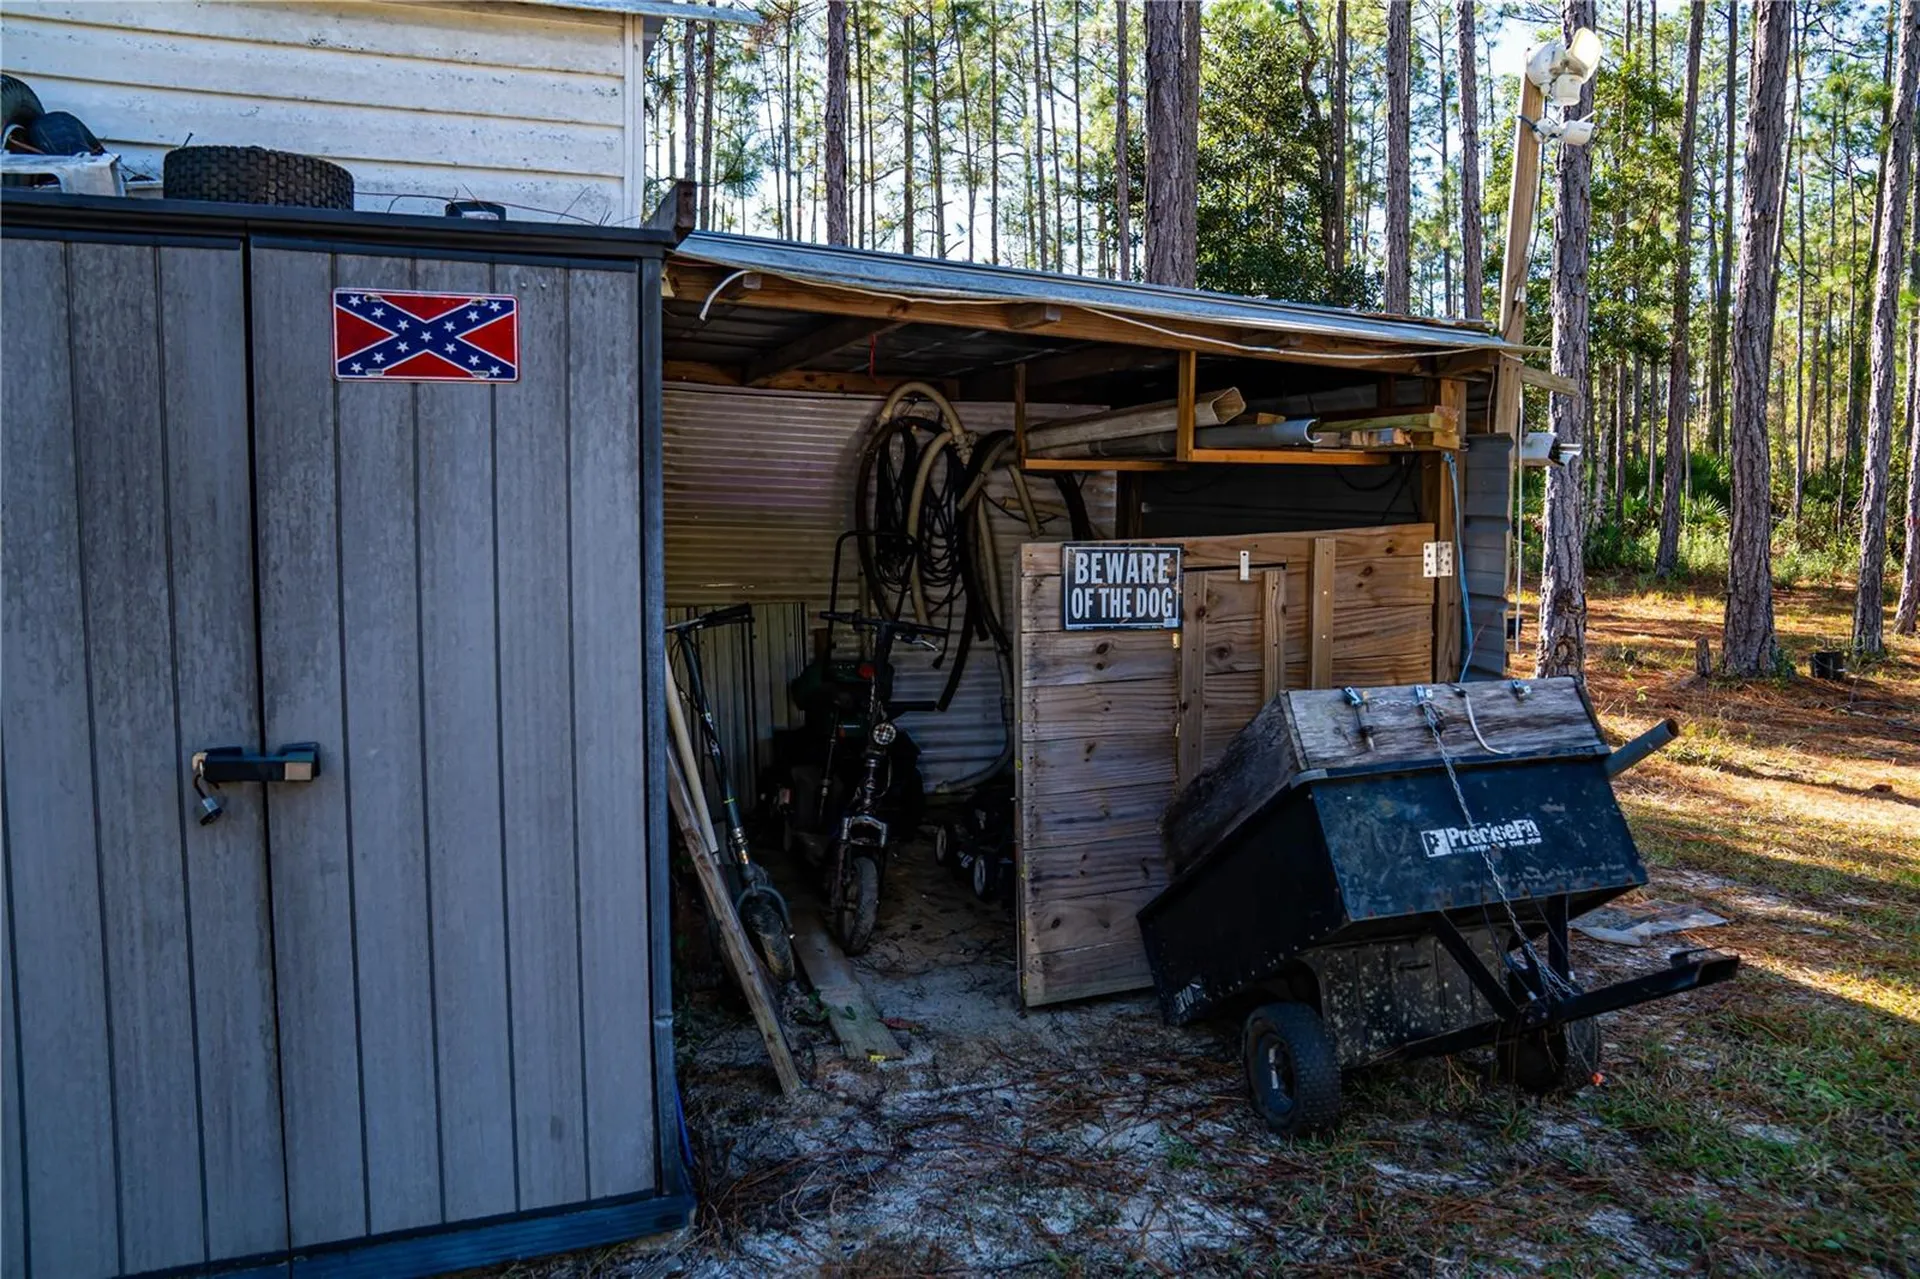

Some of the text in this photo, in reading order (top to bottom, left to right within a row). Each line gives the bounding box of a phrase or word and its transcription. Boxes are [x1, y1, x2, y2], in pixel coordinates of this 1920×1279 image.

[1075, 552, 1170, 584] BEWARE
[1071, 587, 1173, 619] OF THE DOG
